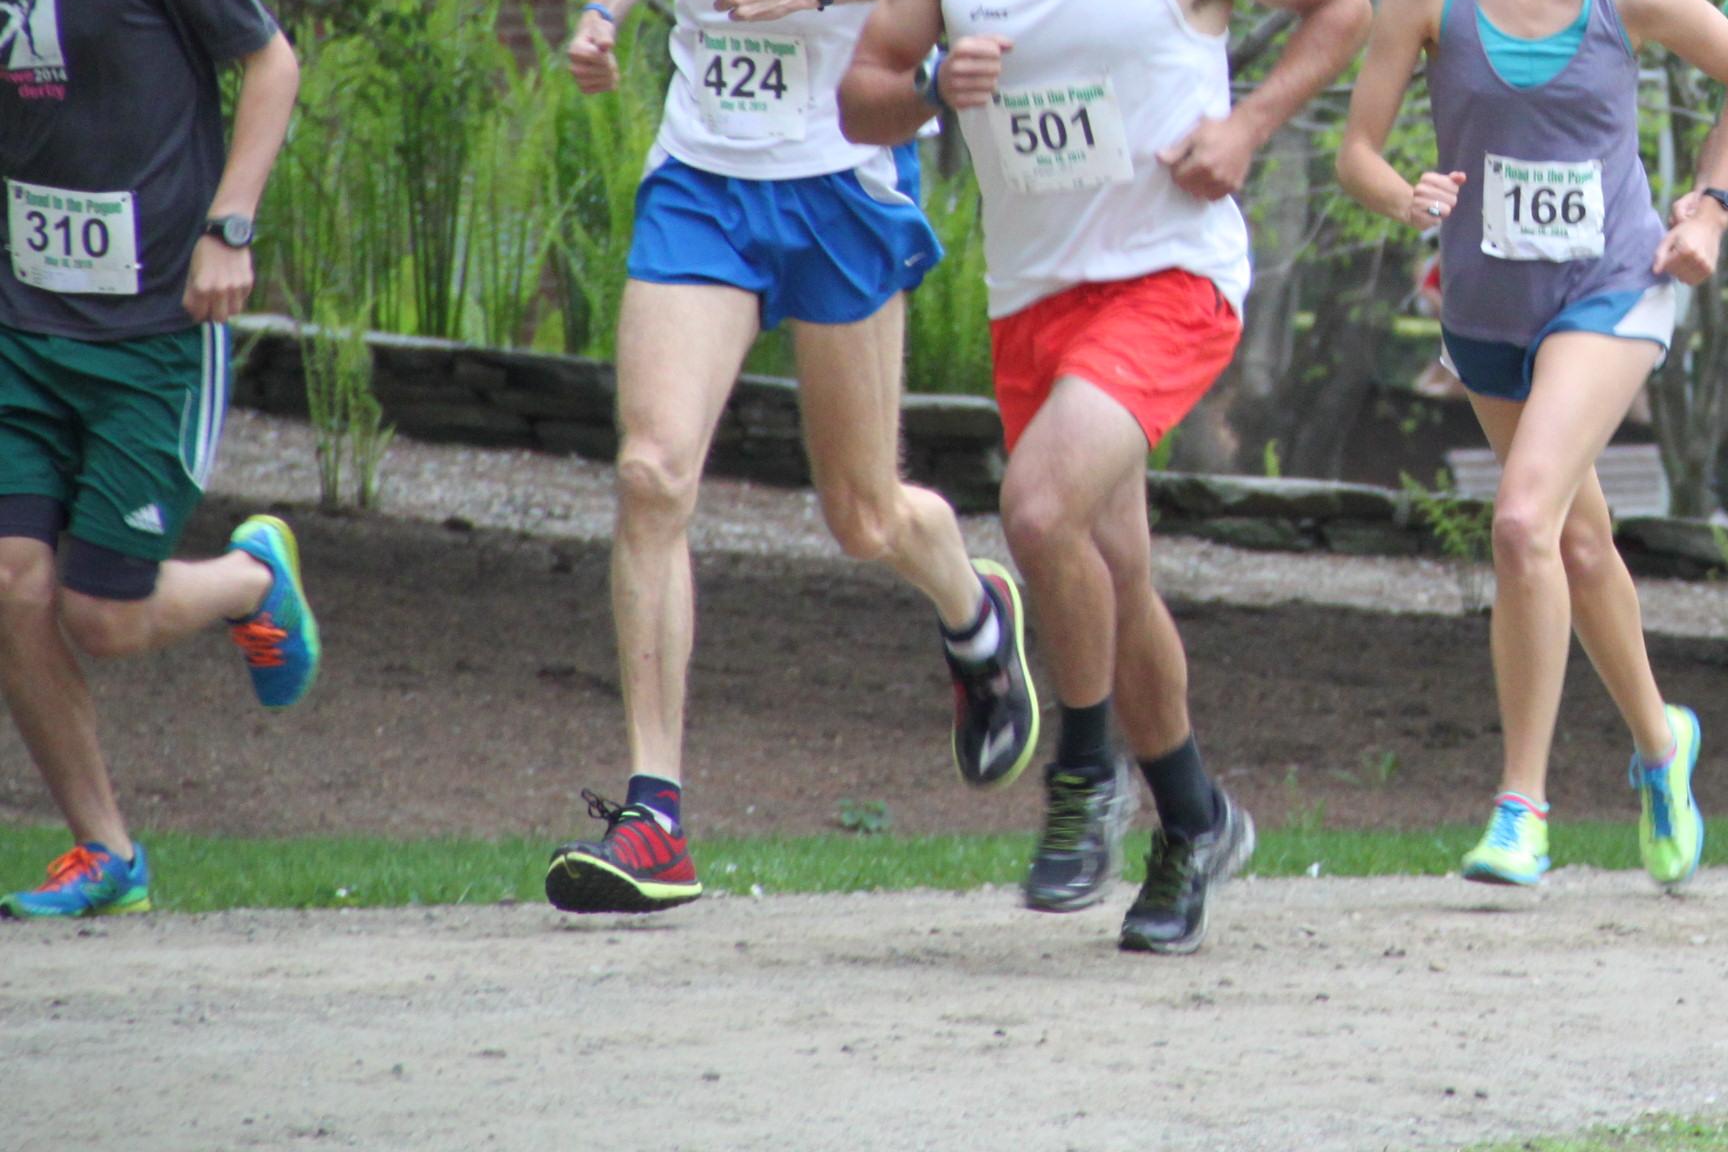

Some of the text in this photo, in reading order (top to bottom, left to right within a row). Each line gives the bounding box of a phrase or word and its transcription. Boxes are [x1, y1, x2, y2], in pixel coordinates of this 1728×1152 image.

[704, 55, 788, 99] 424
[1011, 105, 1095, 155] 501
[1504, 185, 1586, 226] 166
[26, 210, 110, 258] 310
